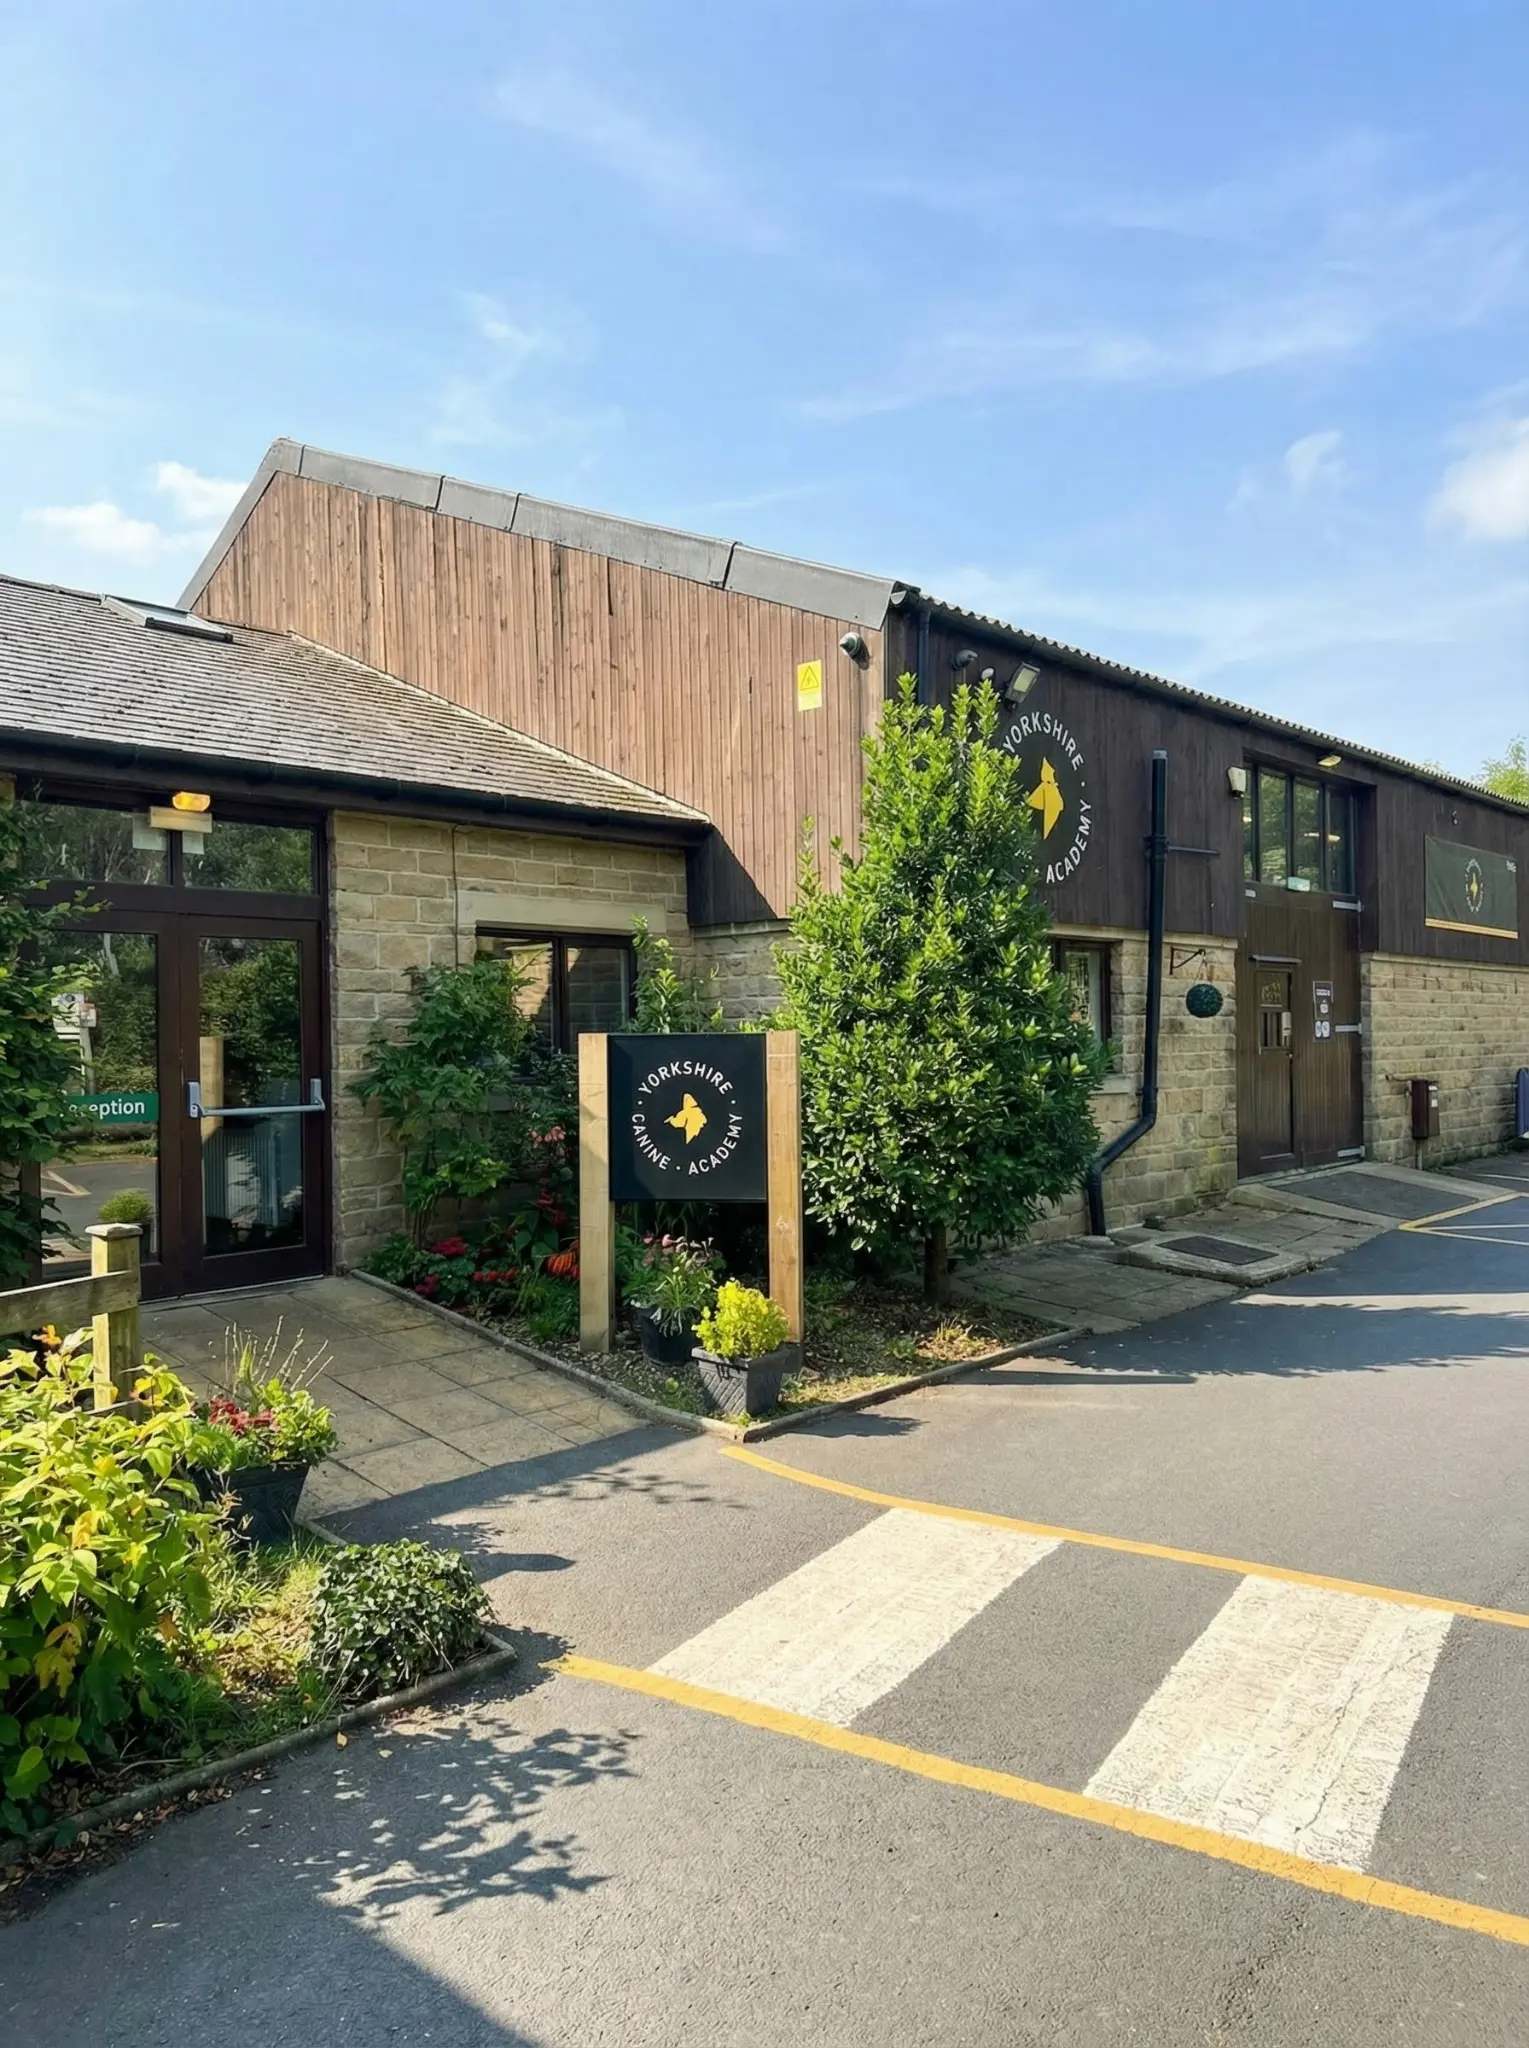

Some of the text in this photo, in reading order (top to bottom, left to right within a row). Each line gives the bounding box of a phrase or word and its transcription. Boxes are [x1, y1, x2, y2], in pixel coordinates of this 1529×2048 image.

[1003, 711, 1091, 884] YORKSHIRE ACADEMY
[632, 1060, 743, 1175] YORKSHIRE CANINE ACADEMY
